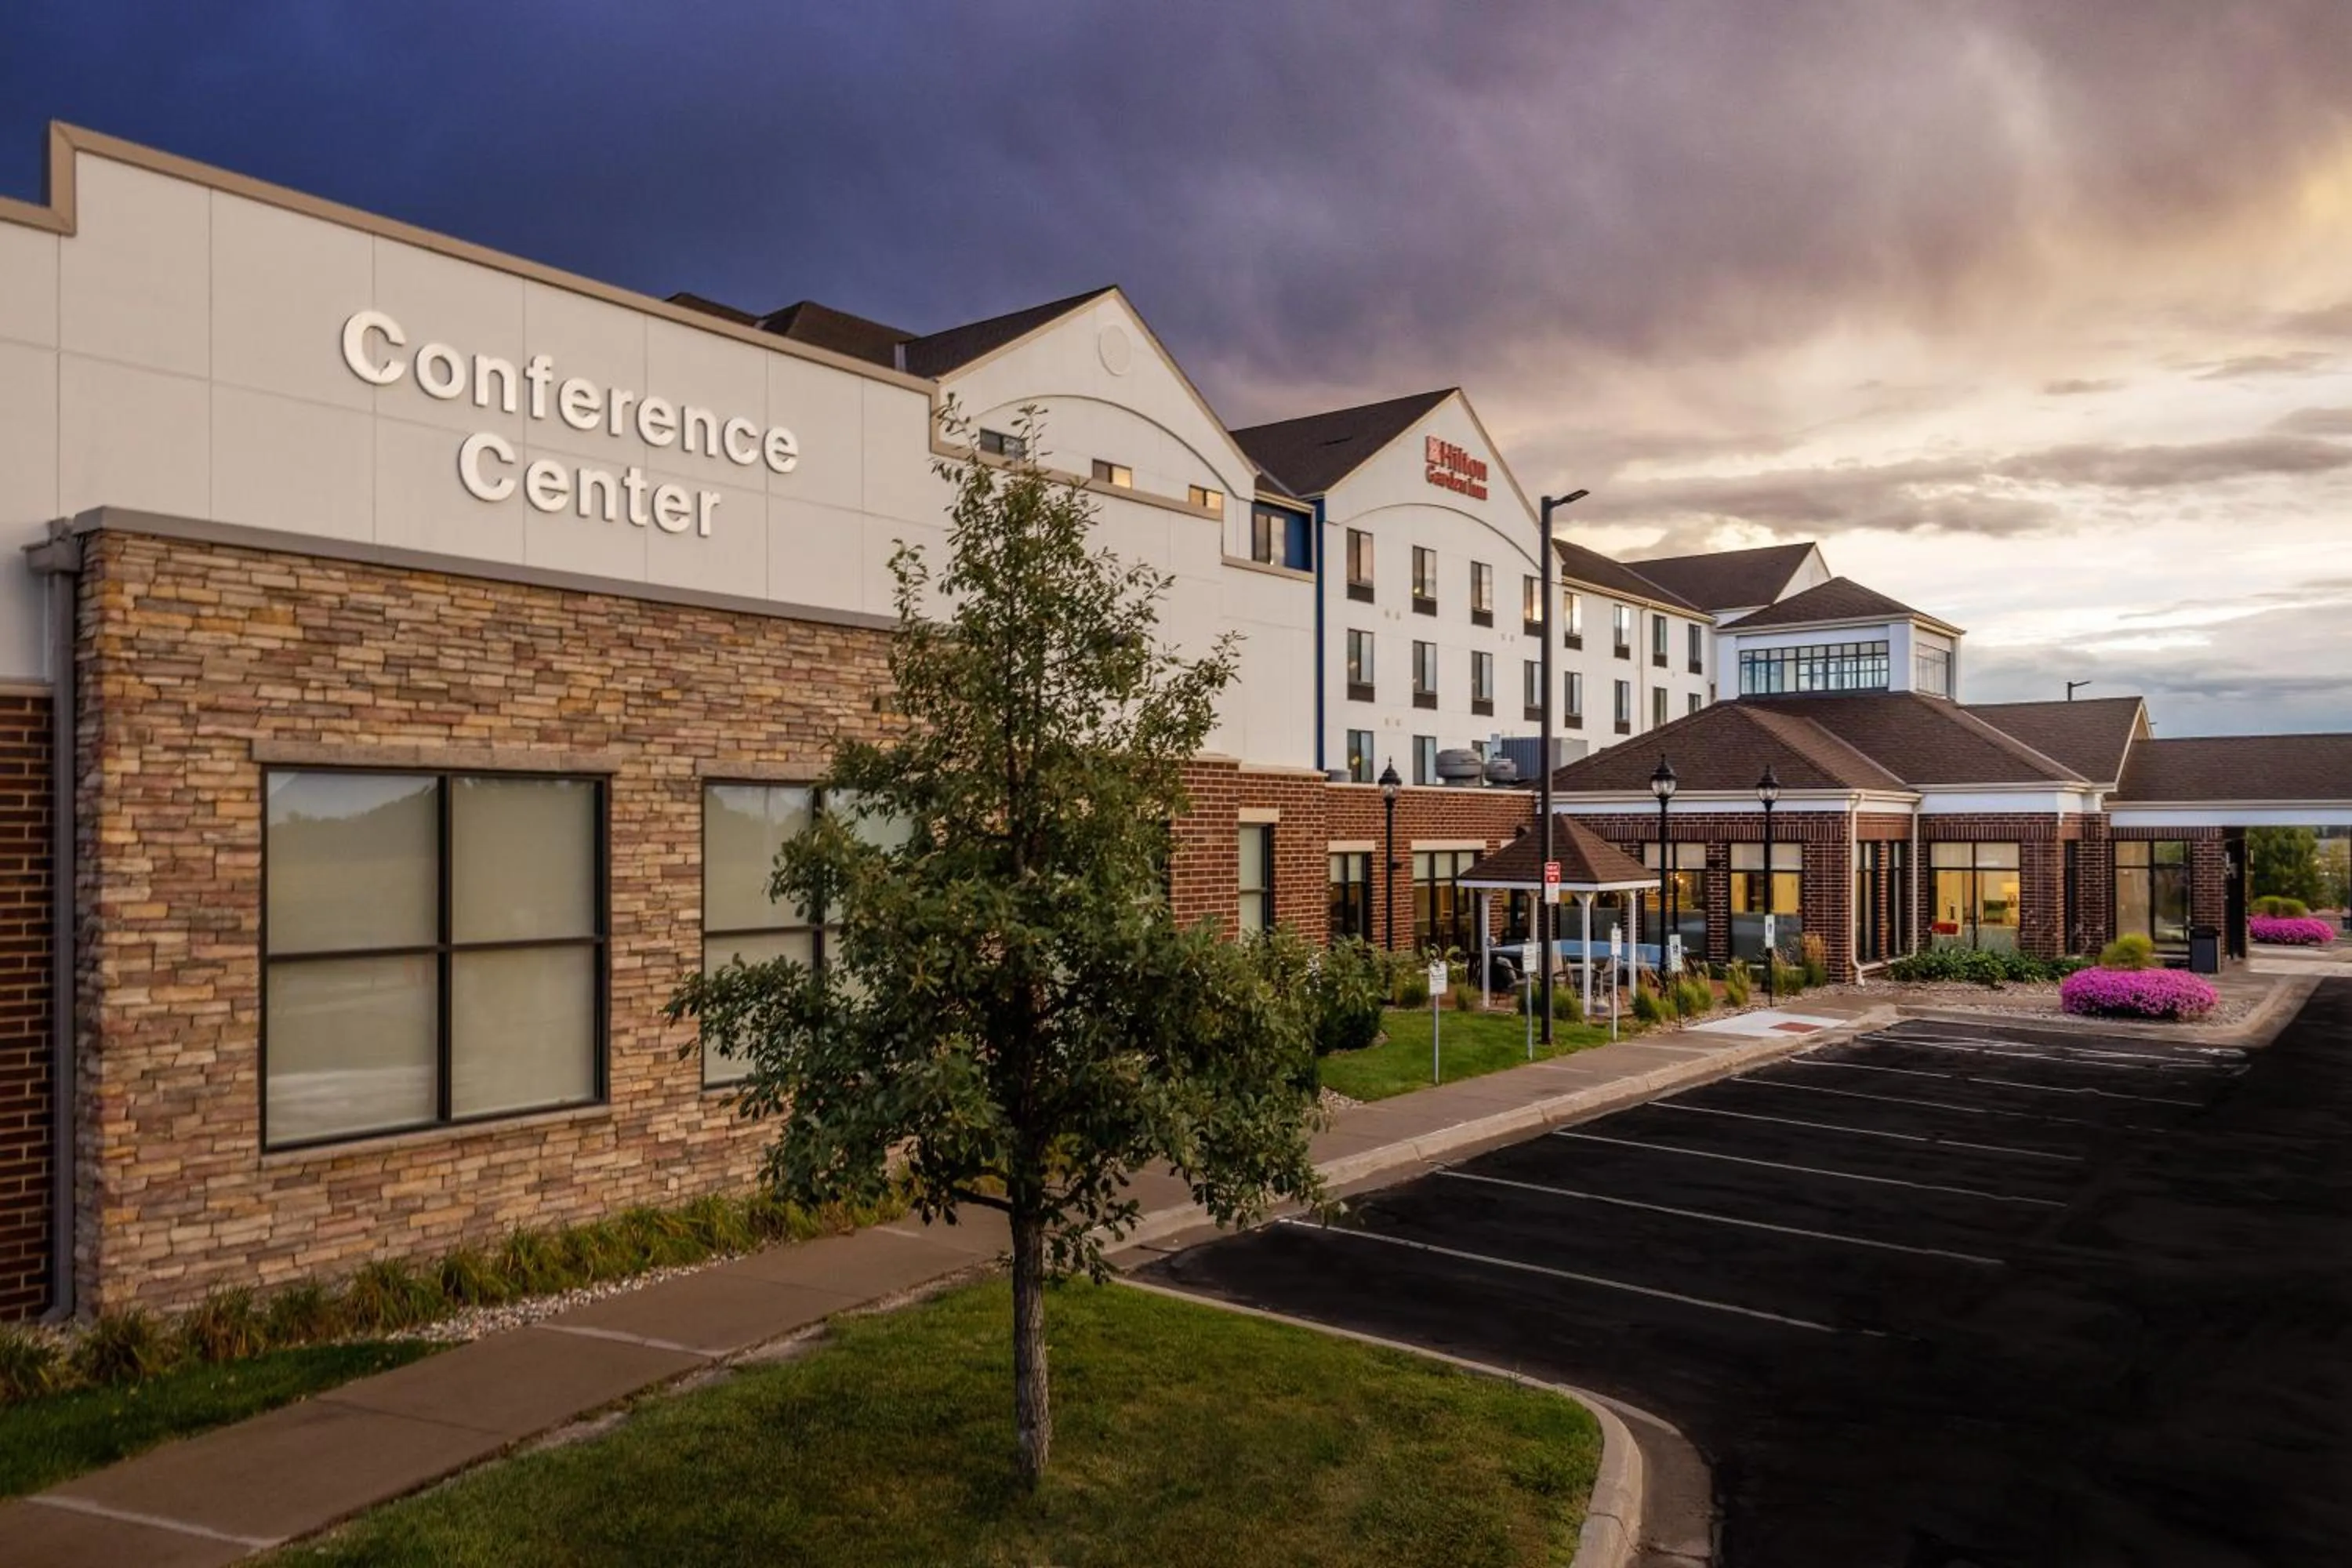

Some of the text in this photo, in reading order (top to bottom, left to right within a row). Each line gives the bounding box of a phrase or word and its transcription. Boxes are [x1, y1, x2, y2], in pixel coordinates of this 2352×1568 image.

[342, 310, 799, 474] Conference
[459, 432, 720, 538] Center
[1440, 441, 1487, 482] Hilton
